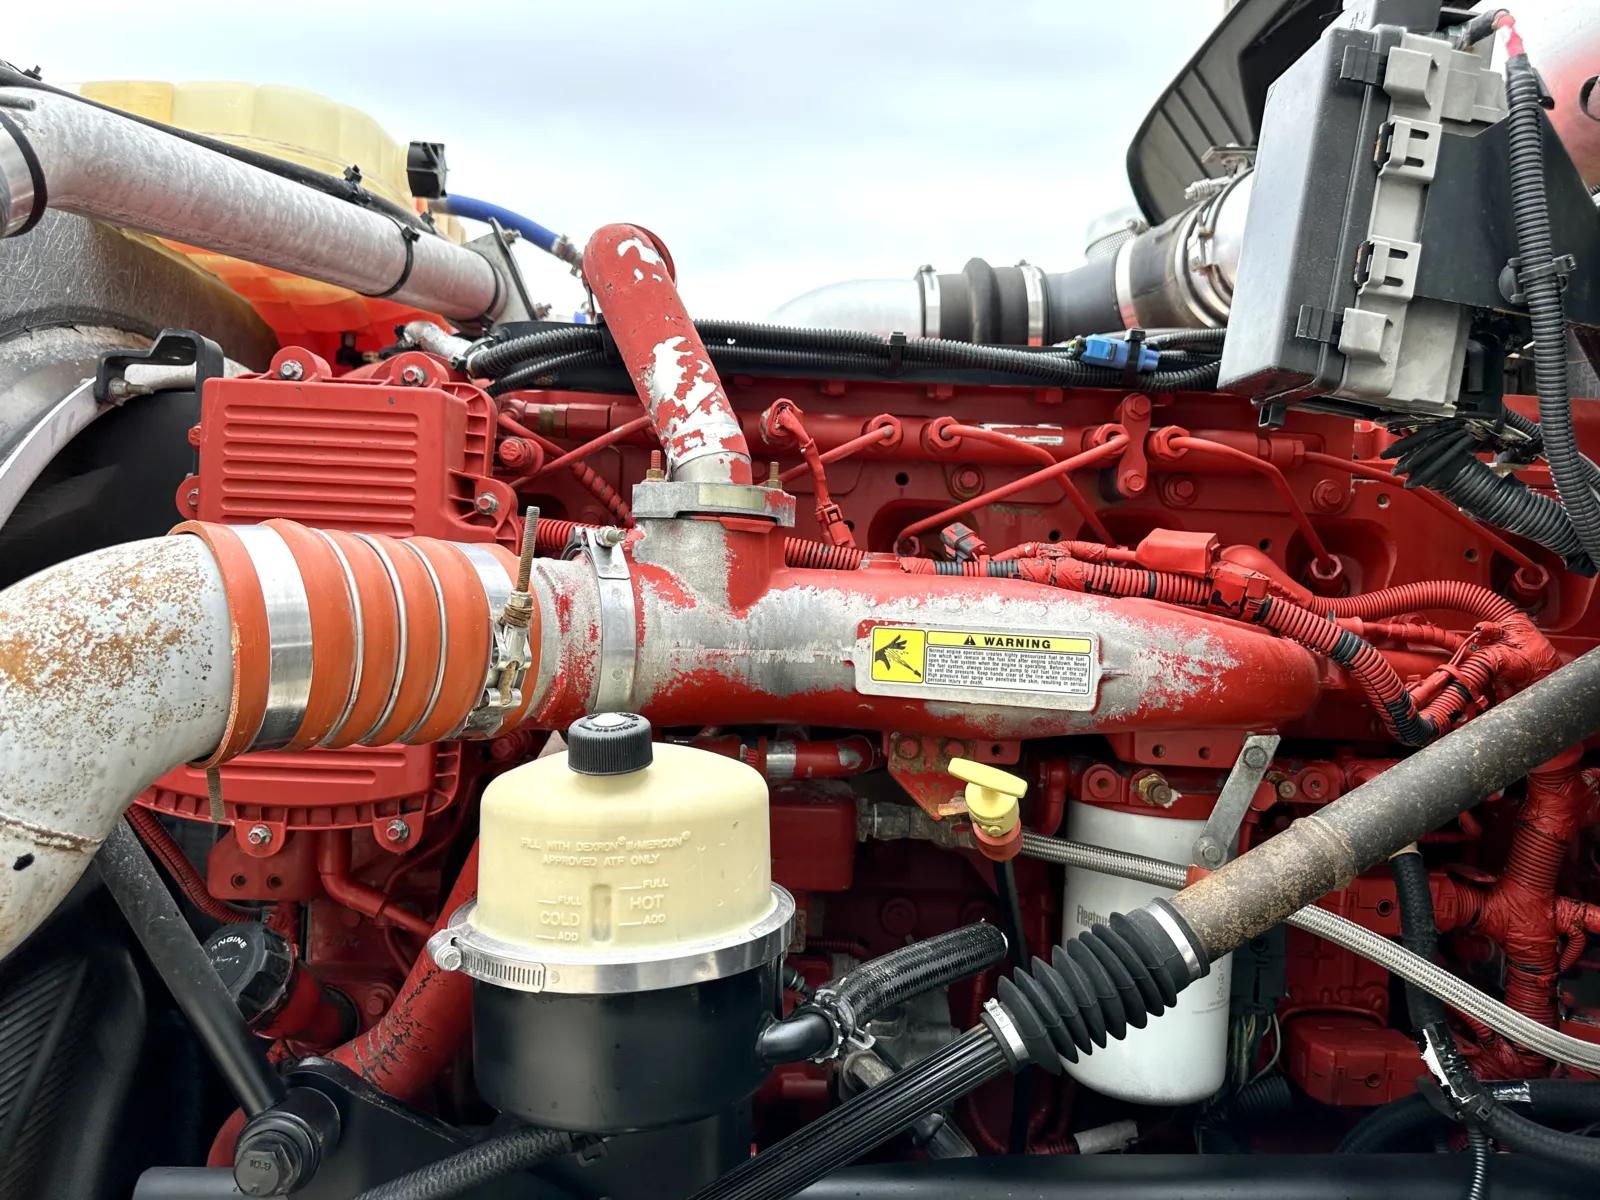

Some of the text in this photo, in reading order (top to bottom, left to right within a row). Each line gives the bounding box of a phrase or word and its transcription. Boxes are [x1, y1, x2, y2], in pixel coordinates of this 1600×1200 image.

[984, 636, 1051, 649] WARNING
[546, 840, 570, 850] WITH
[542, 853, 660, 866] APPROVED ATF ONLY
[642, 878, 669, 889] FULL
[558, 896, 582, 906] FULL
[629, 894, 664, 910] HOT
[540, 910, 580, 926] COLD
[642, 914, 666, 925] ADD
[557, 932, 579, 942] ADD
